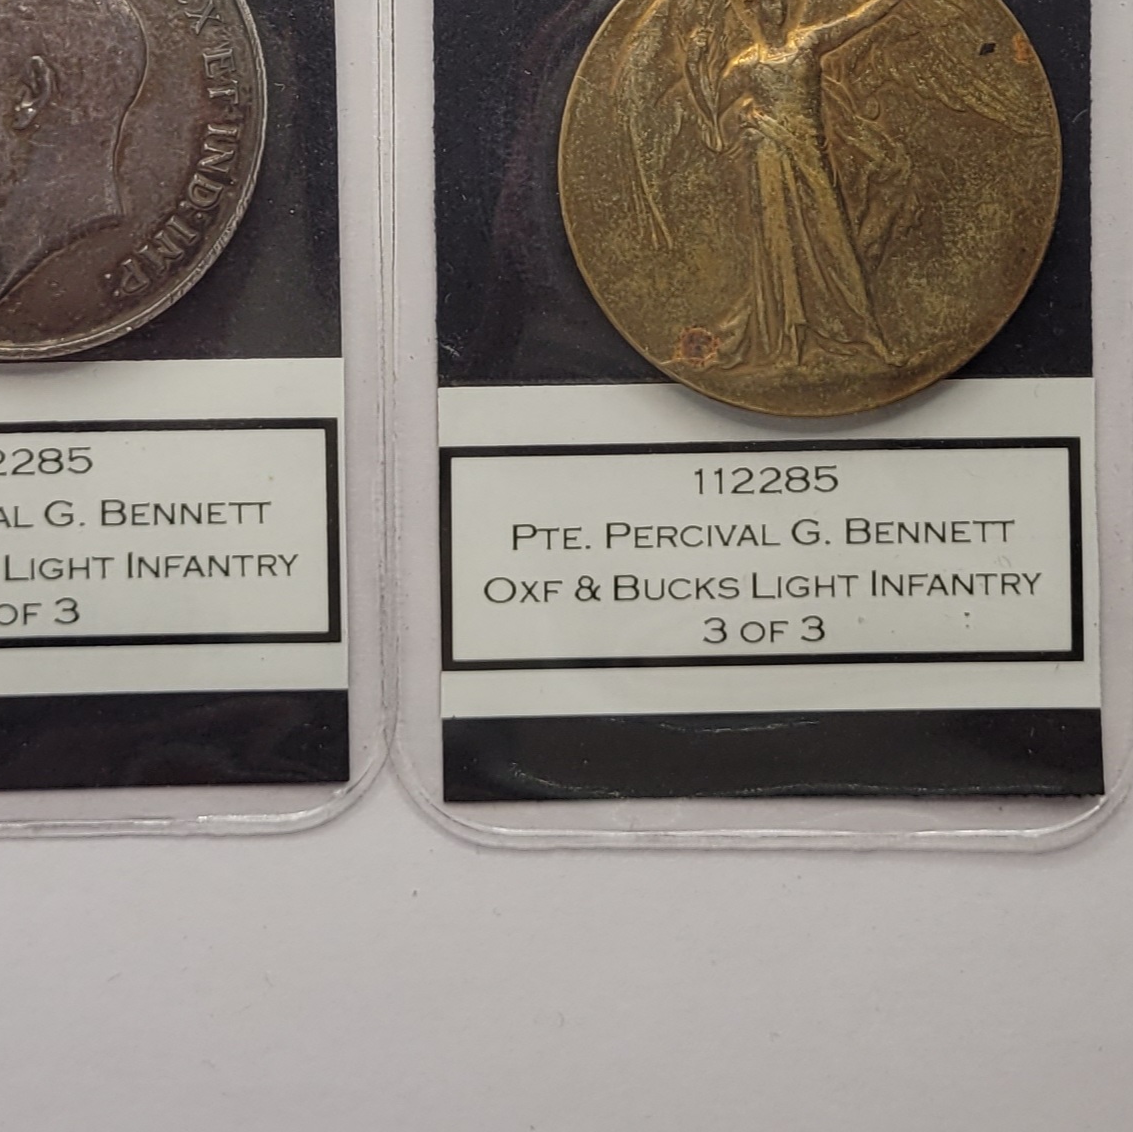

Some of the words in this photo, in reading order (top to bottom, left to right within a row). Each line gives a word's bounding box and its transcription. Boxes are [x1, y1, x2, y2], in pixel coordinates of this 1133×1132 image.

[202, 47, 239, 105] ET
[693, 464, 840, 496] 112285
[42, 499, 86, 529] G.
[100, 498, 272, 528] BENNETT
[511, 523, 592, 552] PTE.
[605, 521, 781, 550] PERCIVAL
[790, 518, 831, 547] G.
[844, 517, 1016, 546] BENNETT
[3, 554, 115, 583] LIGHT
[126, 551, 299, 580] INFANTRY
[482, 576, 564, 605] OXF
[573, 574, 602, 603] &
[612, 573, 741, 603] BUCKS
[751, 571, 860, 600] LIGHT
[870, 569, 1042, 598] INFANTRY
[53, 596, 81, 626] 3
[702, 616, 729, 646] 3
[739, 620, 789, 645] OF
[800, 614, 827, 644] 3
